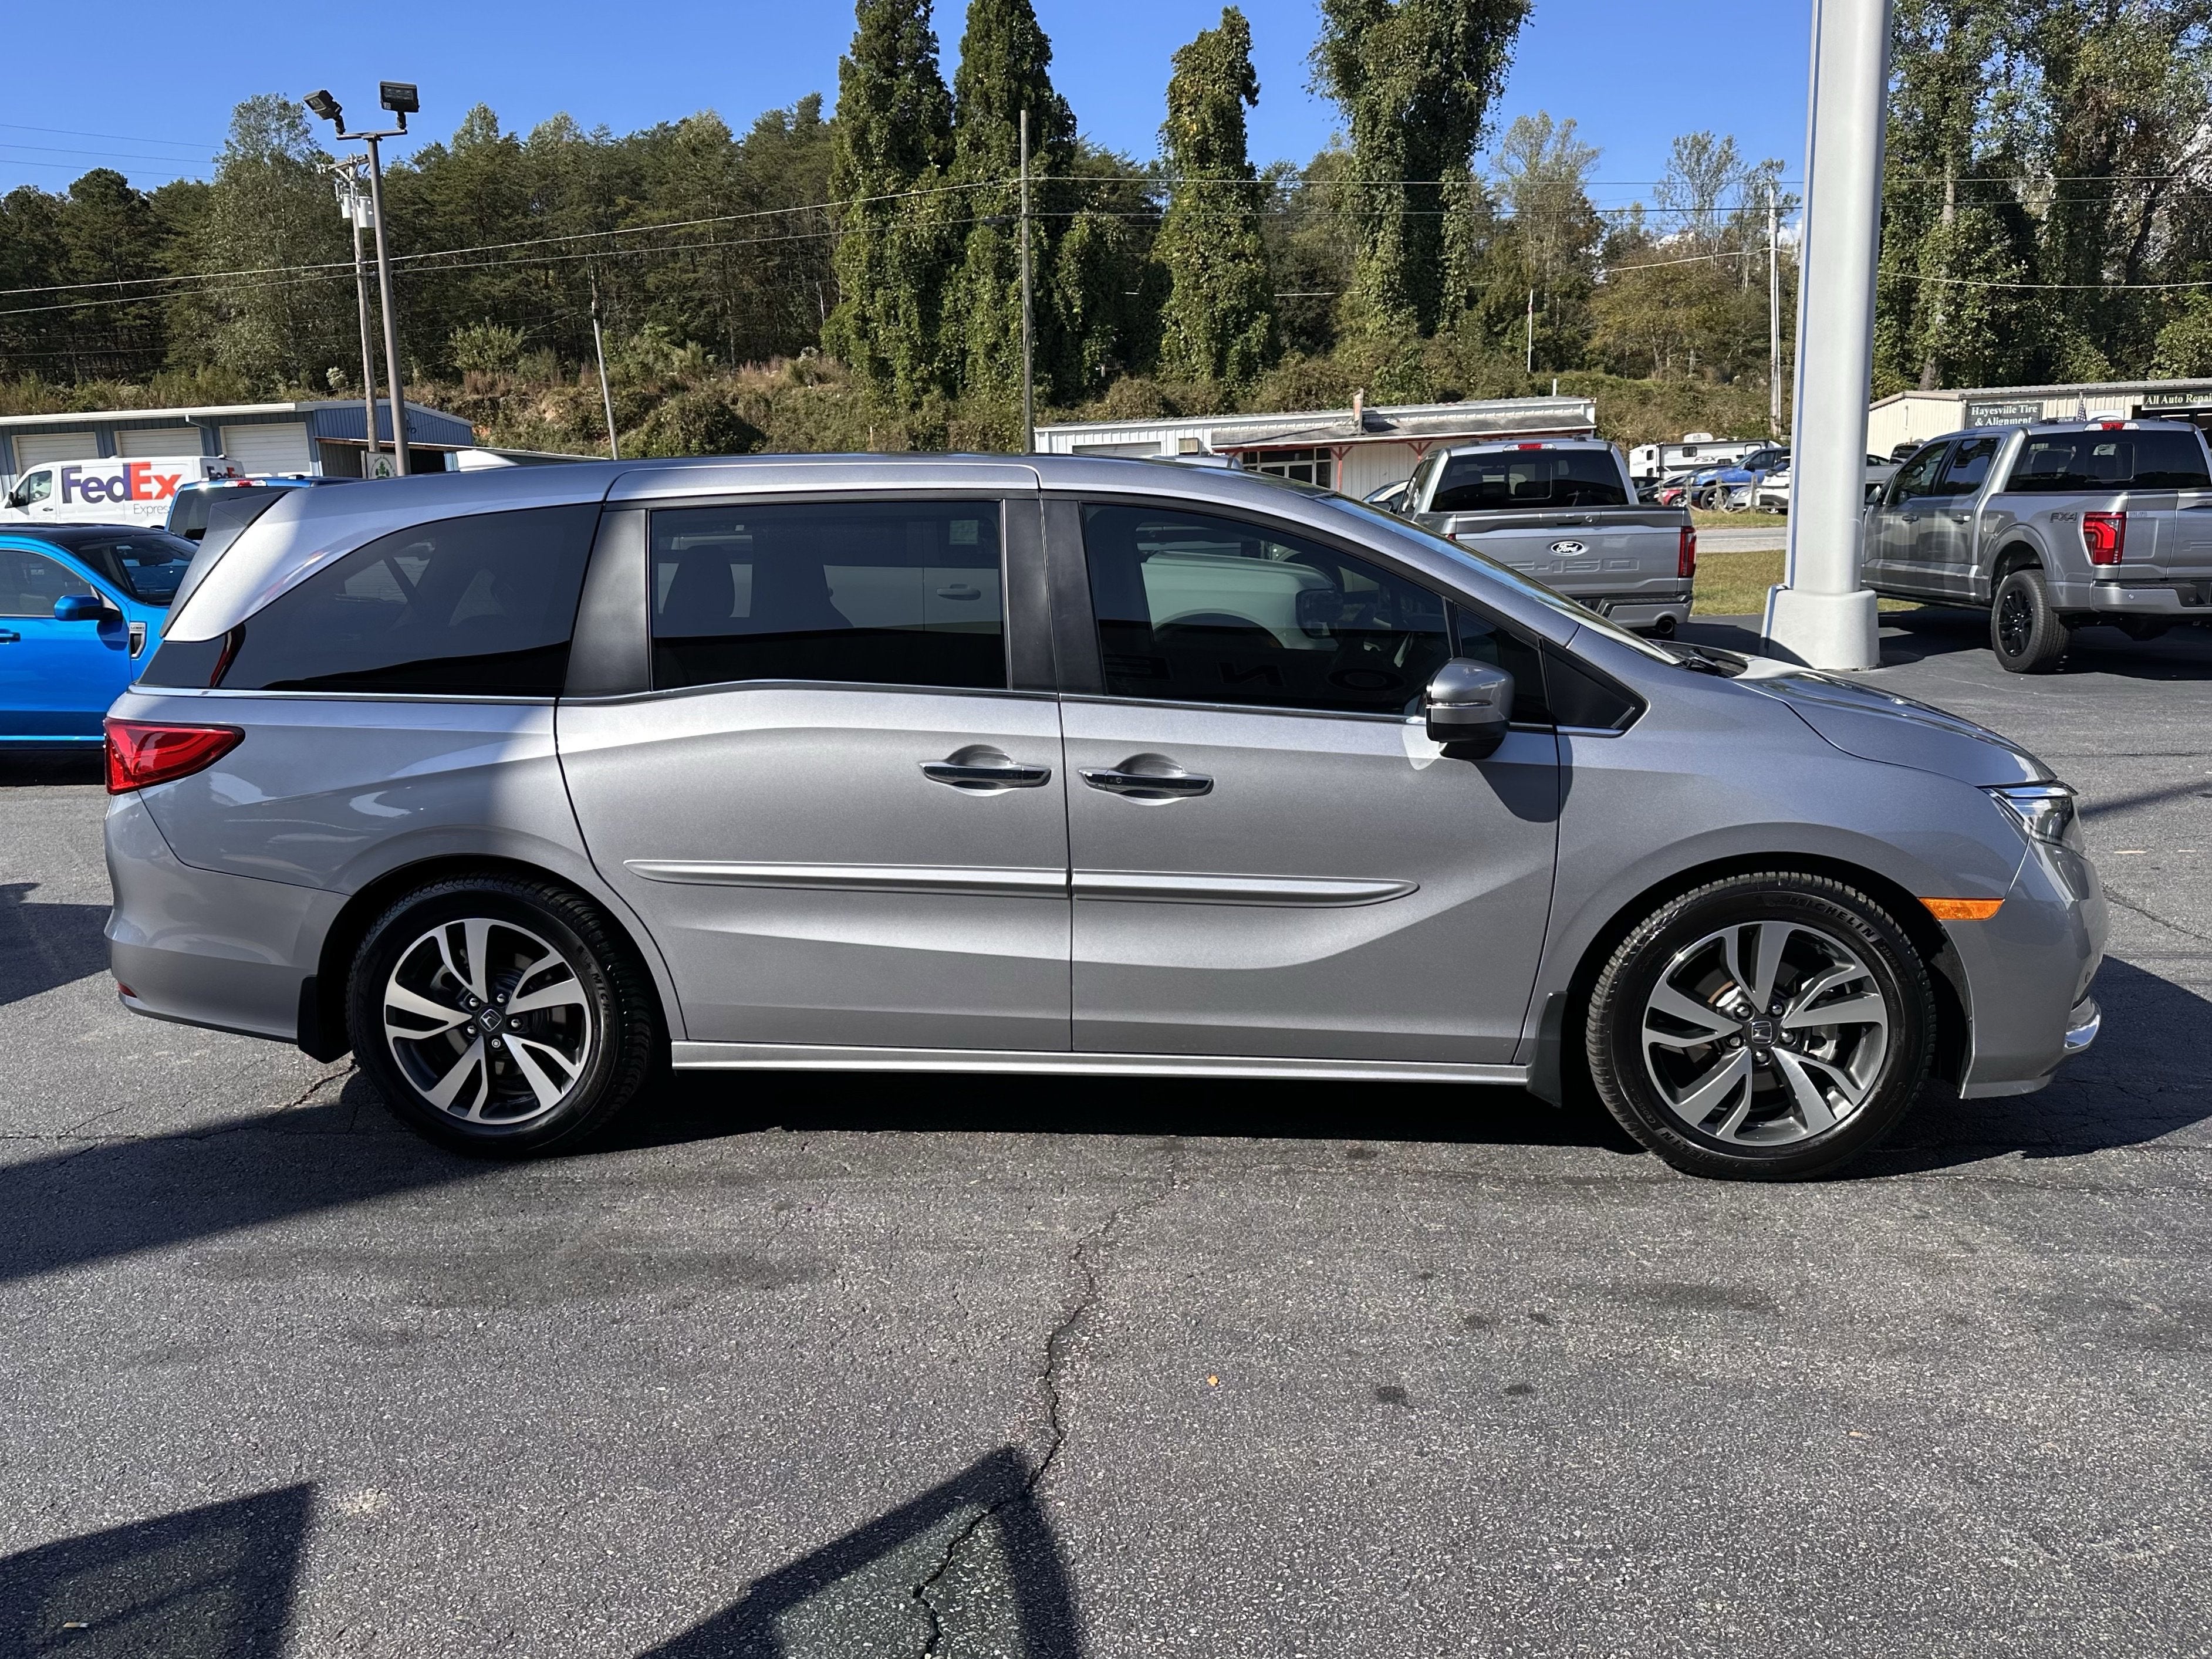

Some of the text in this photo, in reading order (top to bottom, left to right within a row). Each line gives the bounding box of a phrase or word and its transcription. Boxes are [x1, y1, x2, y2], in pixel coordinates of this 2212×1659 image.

[2145, 392, 2212, 405] All Auto Repai
[1971, 404, 2038, 417] Hayesville Tire
[1975, 416, 2032, 426] & Alignment
[62, 462, 182, 504] FedEx
[133, 504, 170, 516] Expres
[2050, 512, 2078, 522] FX4
[1556, 542, 1579, 553] Ford
[1788, 894, 1876, 940] MICHELIN
